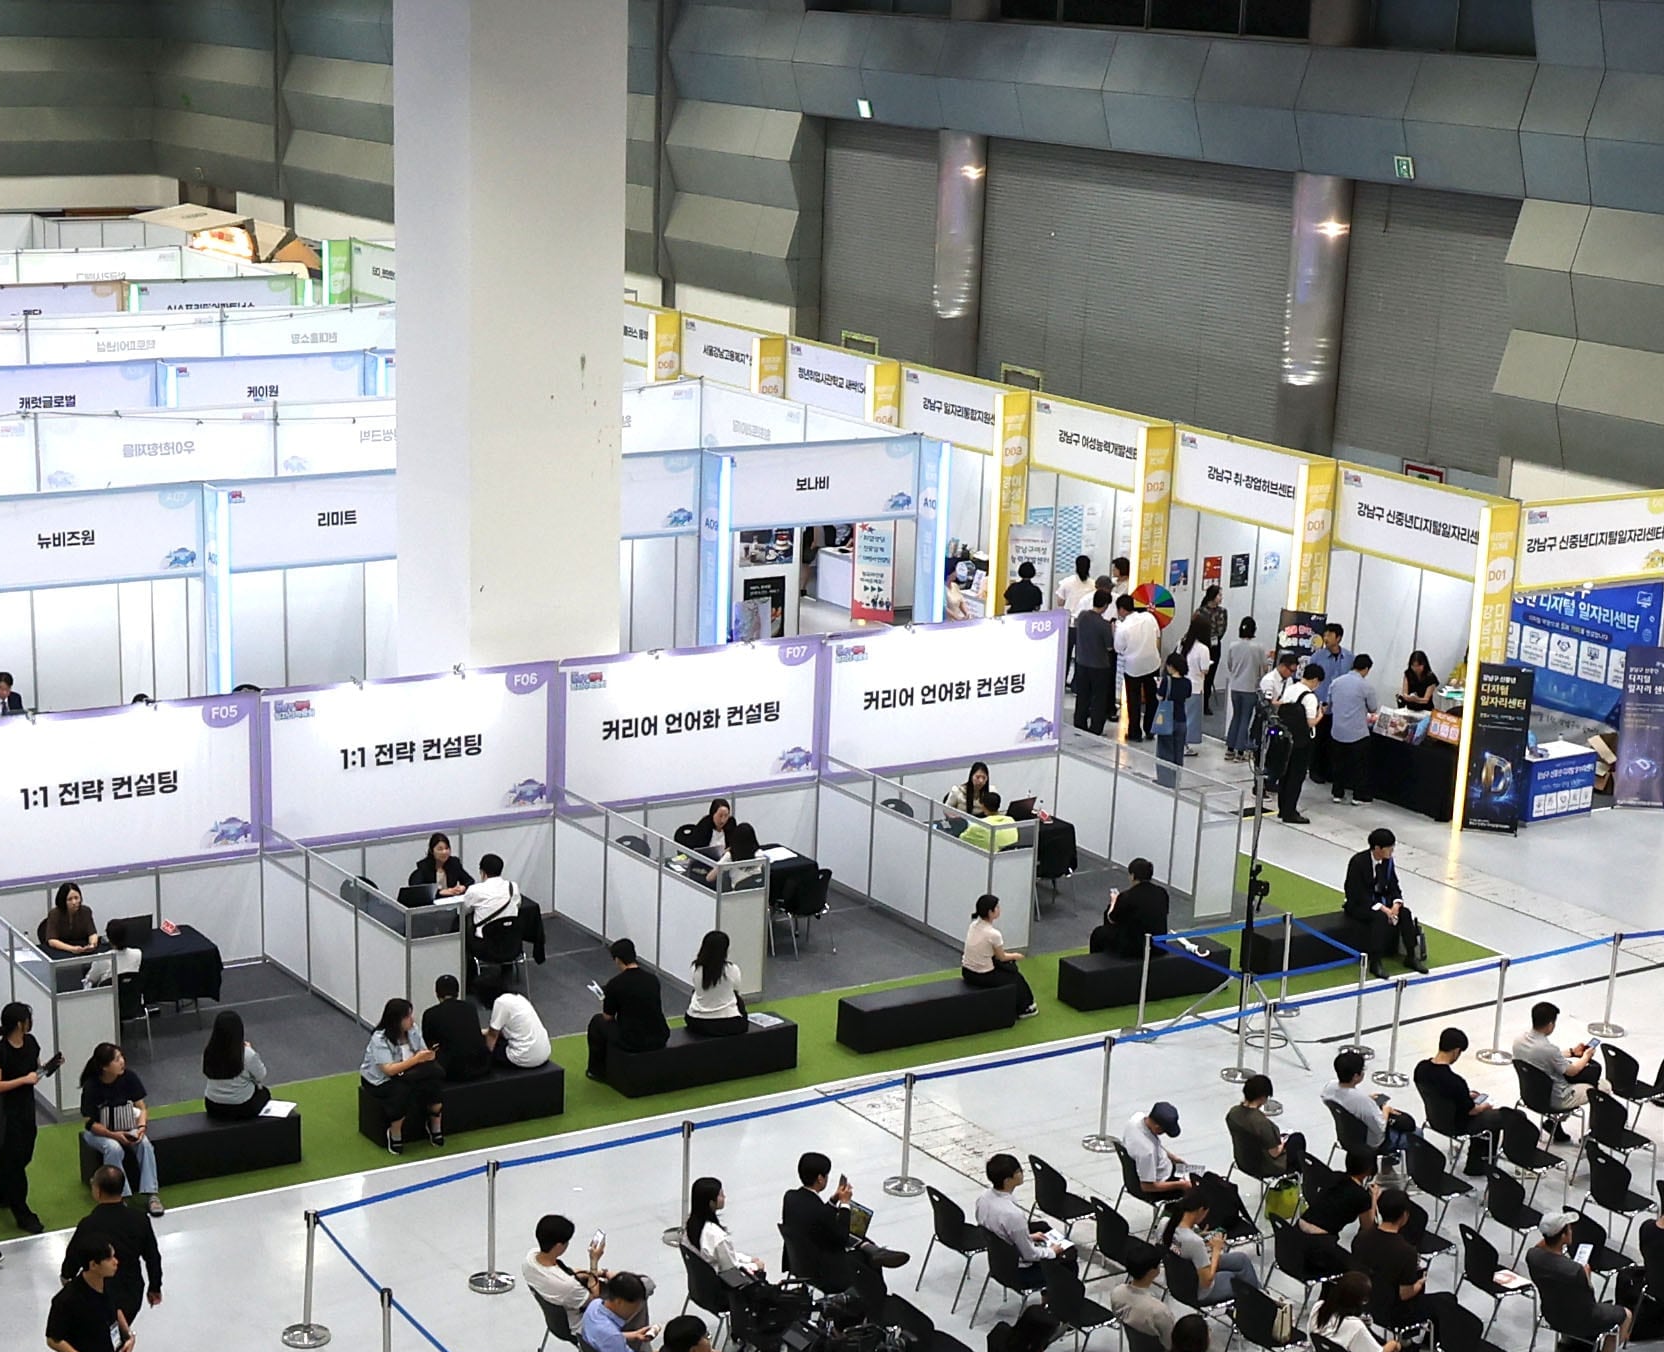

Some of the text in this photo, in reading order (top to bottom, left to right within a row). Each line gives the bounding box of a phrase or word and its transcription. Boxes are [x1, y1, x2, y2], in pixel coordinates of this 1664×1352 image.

[923, 397, 995, 425] 강남구 일자리통합지원센
[1058, 429, 1080, 446] 강남구
[796, 476, 830, 492] 보나비
[1207, 465, 1233, 484] 강남구
[317, 509, 358, 529] 리미트
[1357, 501, 1479, 546] 강남구 신중년디지털일자리센
[37, 529, 96, 549] 뉴비즈원
[1526, 526, 1664, 552] 강남구 신중년디지털일자리센터
[1488, 569, 1507, 582] D01
[1539, 594, 1640, 633] 디지털 일자리센터
[1030, 620, 1052, 634] F08
[785, 645, 807, 659] F07
[514, 672, 538, 687] F06
[863, 673, 1026, 712] 커리어 언어화 컨설팅
[1481, 684, 1509, 696] 디지털
[211, 705, 238, 720] F05
[1480, 696, 1527, 711] 일자리센터
[601, 701, 781, 742] 커리어 언어화 컨설팅
[340, 733, 483, 770] 1:1 전략 컨설팅
[19, 769, 179, 812] 1:1 전략 컨설팅
